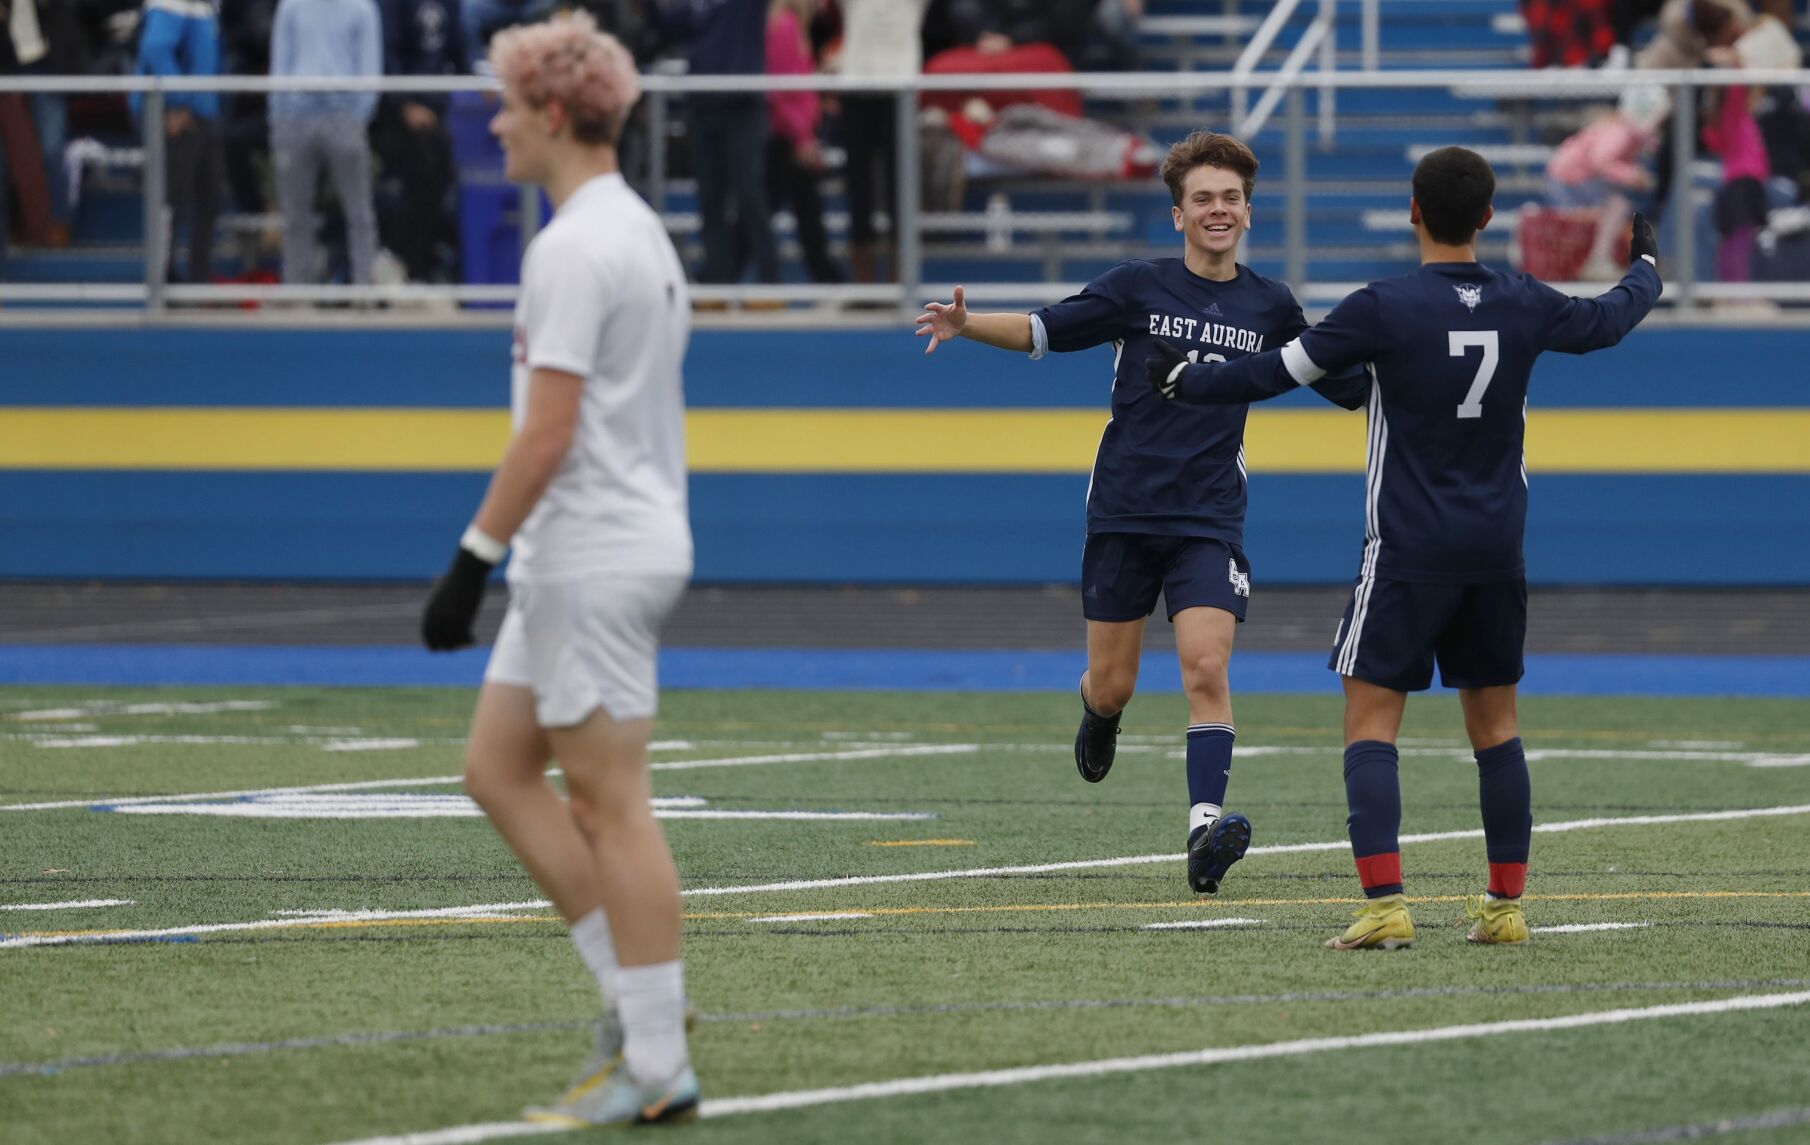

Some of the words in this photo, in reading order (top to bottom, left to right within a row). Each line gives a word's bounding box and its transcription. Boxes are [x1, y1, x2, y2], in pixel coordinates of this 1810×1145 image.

[1149, 314, 1197, 340] EAST
[1201, 321, 1265, 353] AURORA
[1448, 330, 1499, 418] 7
